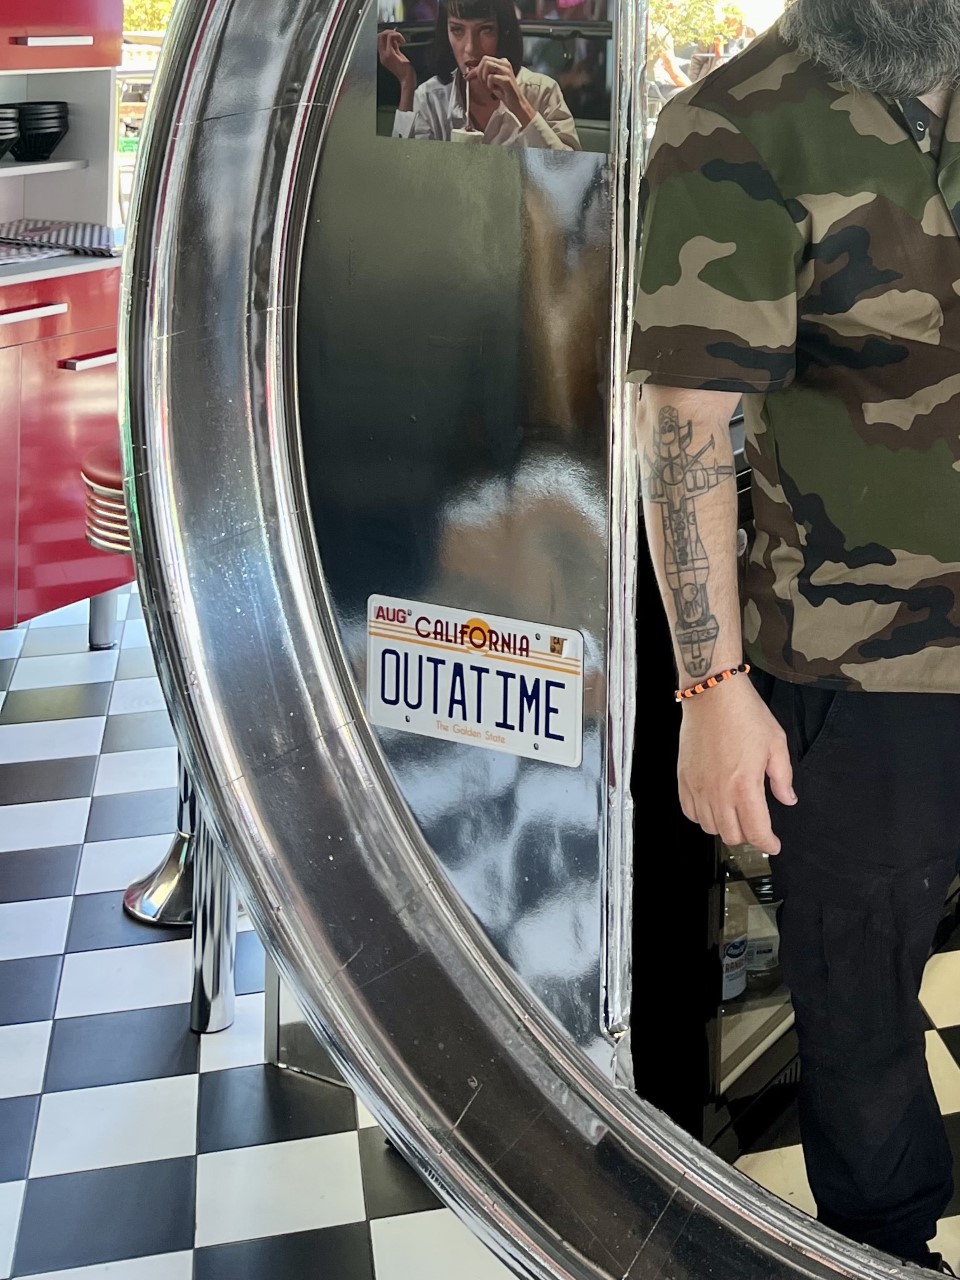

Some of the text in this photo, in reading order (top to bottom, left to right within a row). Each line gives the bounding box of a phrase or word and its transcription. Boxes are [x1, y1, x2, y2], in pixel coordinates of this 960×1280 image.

[375, 605, 407, 624] AUG
[415, 616, 530, 658] CALIFORNIA
[380, 648, 566, 742] OUTATIME
[436, 720, 506, 744] The Golden State
